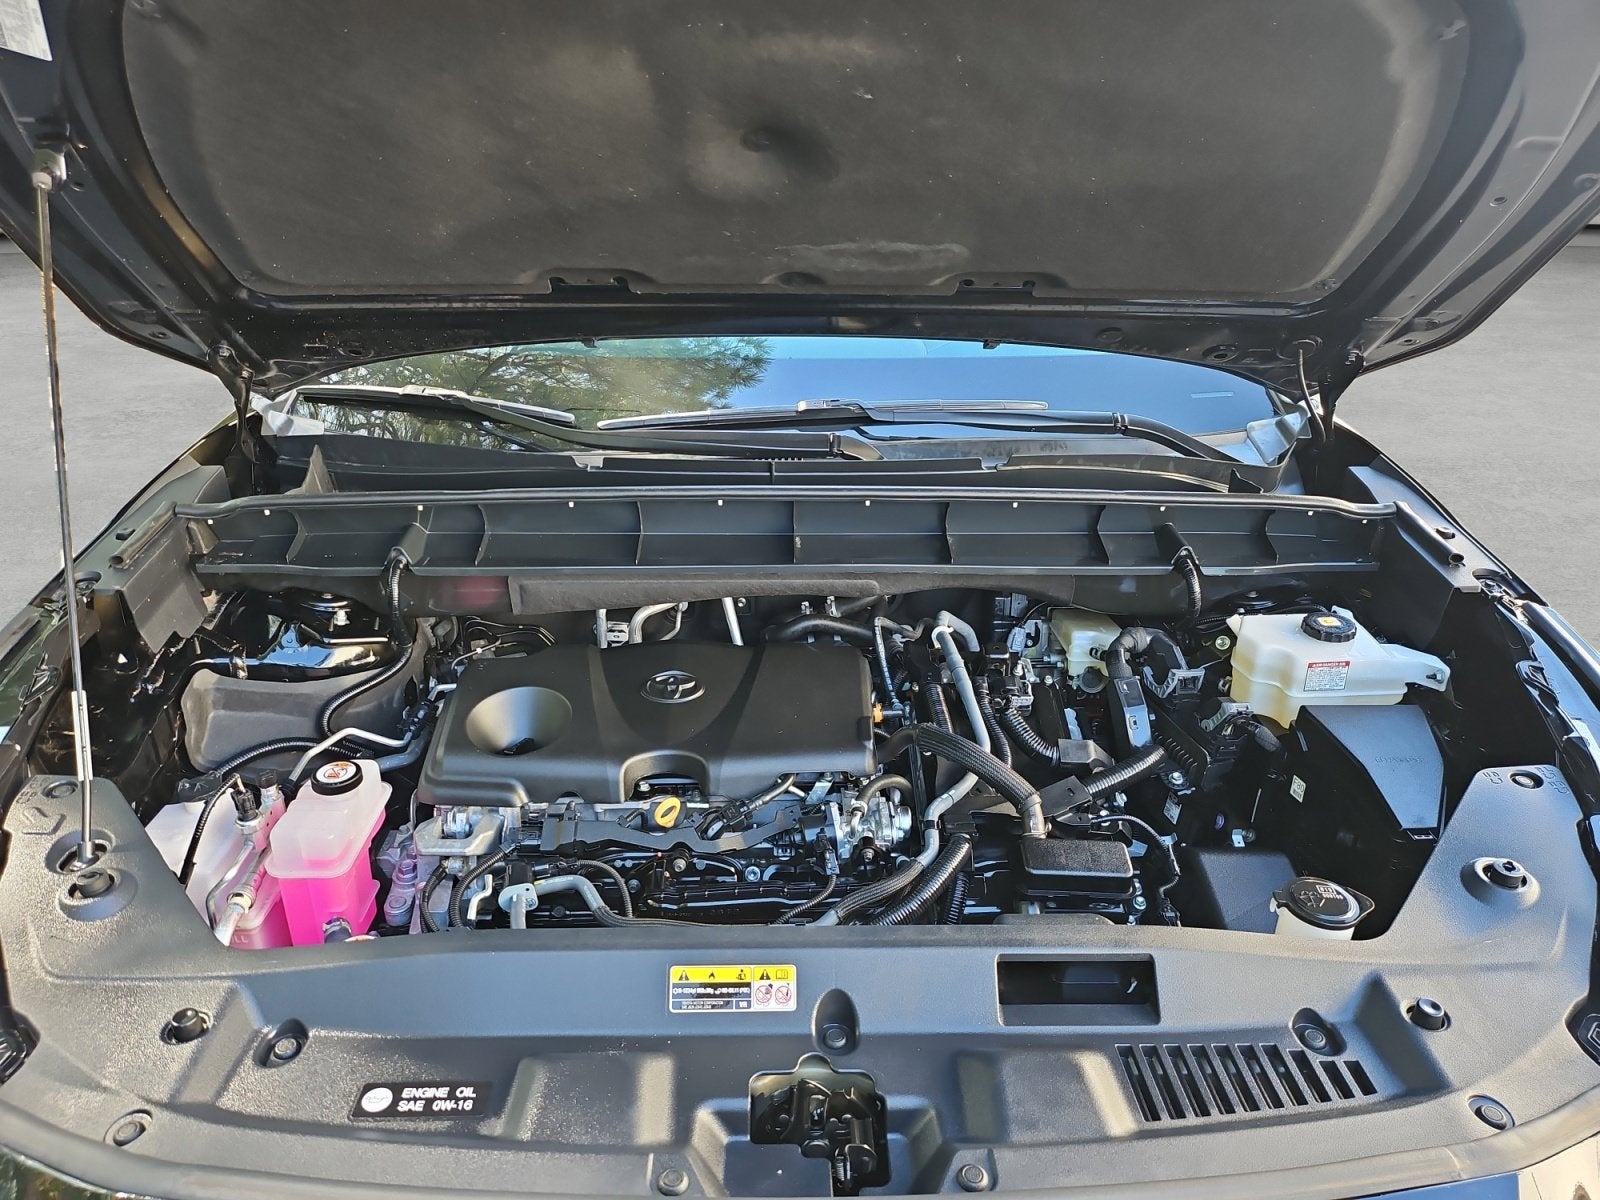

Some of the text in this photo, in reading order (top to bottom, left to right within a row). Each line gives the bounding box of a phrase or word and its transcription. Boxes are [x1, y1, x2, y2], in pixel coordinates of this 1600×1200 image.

[401, 1086, 477, 1098] ENGINE OIL
[397, 1100, 425, 1112] SAE
